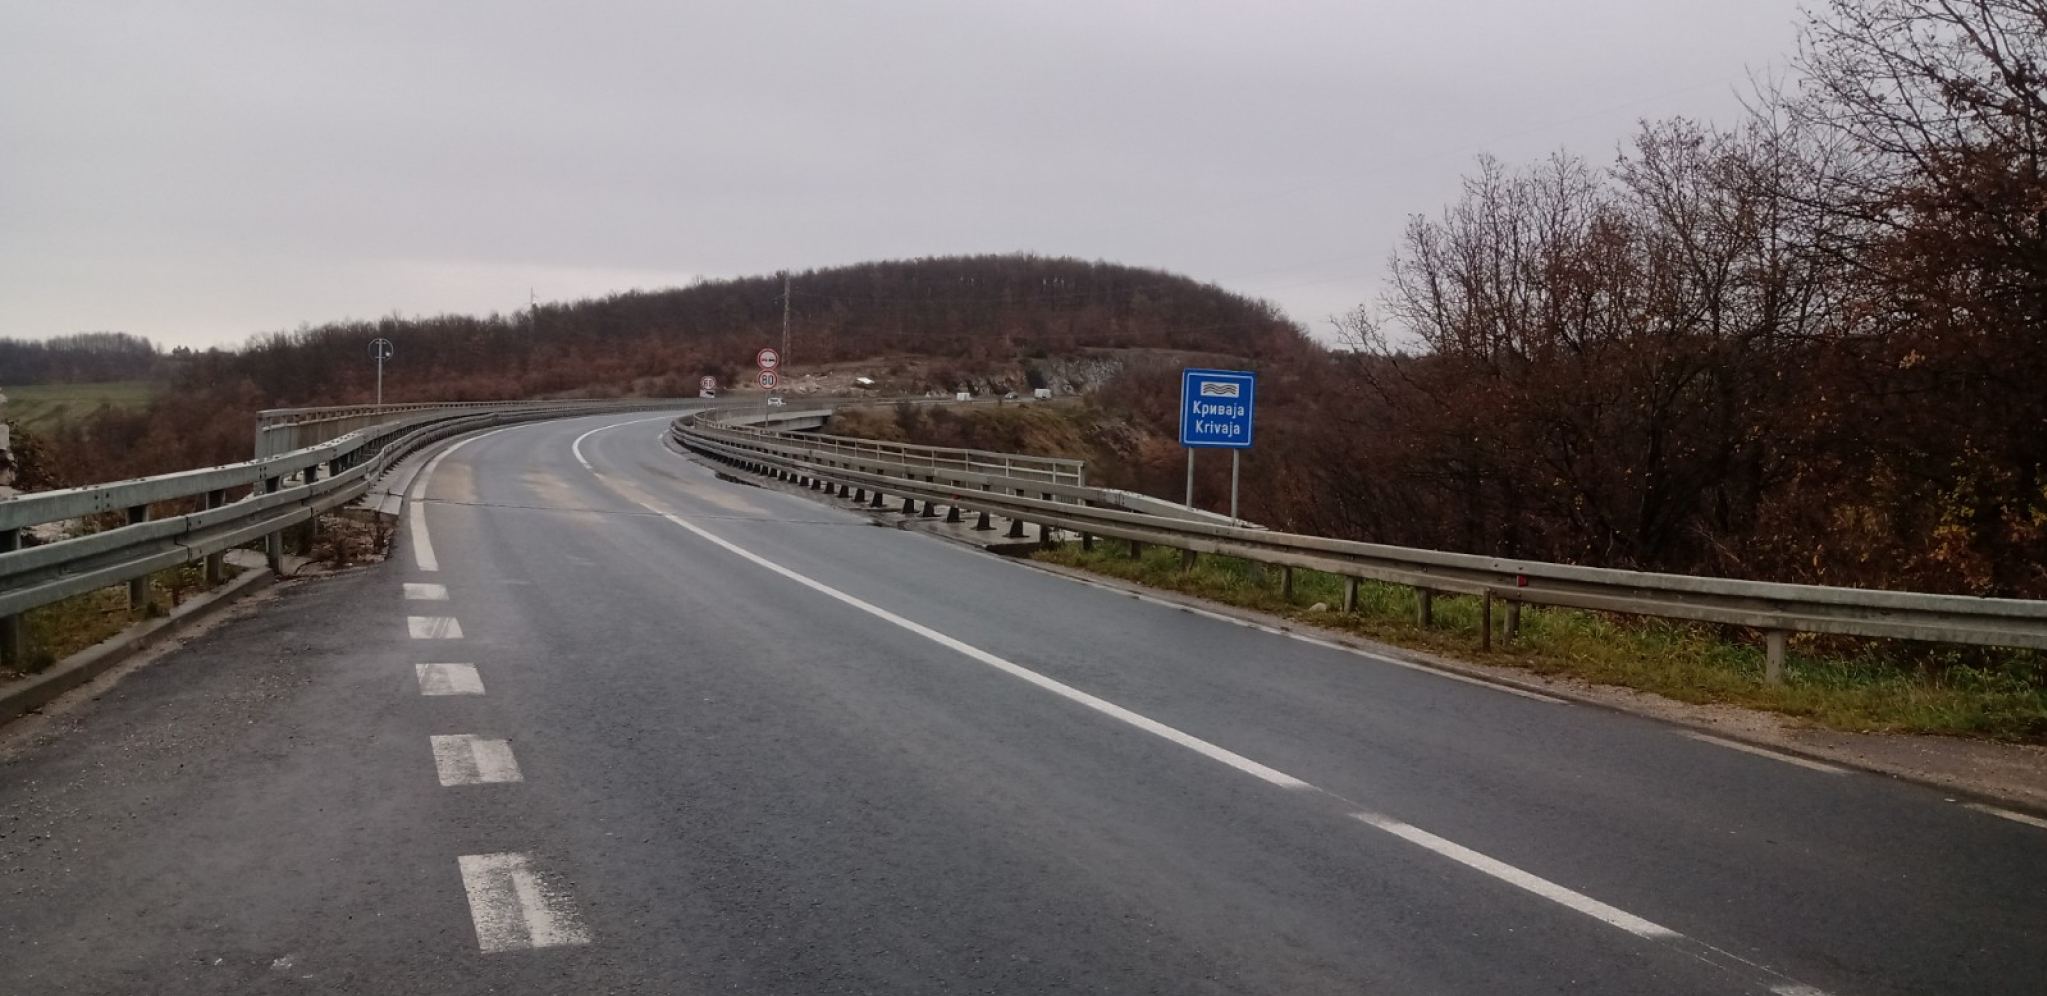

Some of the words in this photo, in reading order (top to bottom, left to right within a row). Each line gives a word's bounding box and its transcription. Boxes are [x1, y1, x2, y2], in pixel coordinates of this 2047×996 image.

[762, 375, 774, 385] 80
[1193, 400, 1245, 419] Криваја
[1196, 420, 1240, 438] Krivaja
